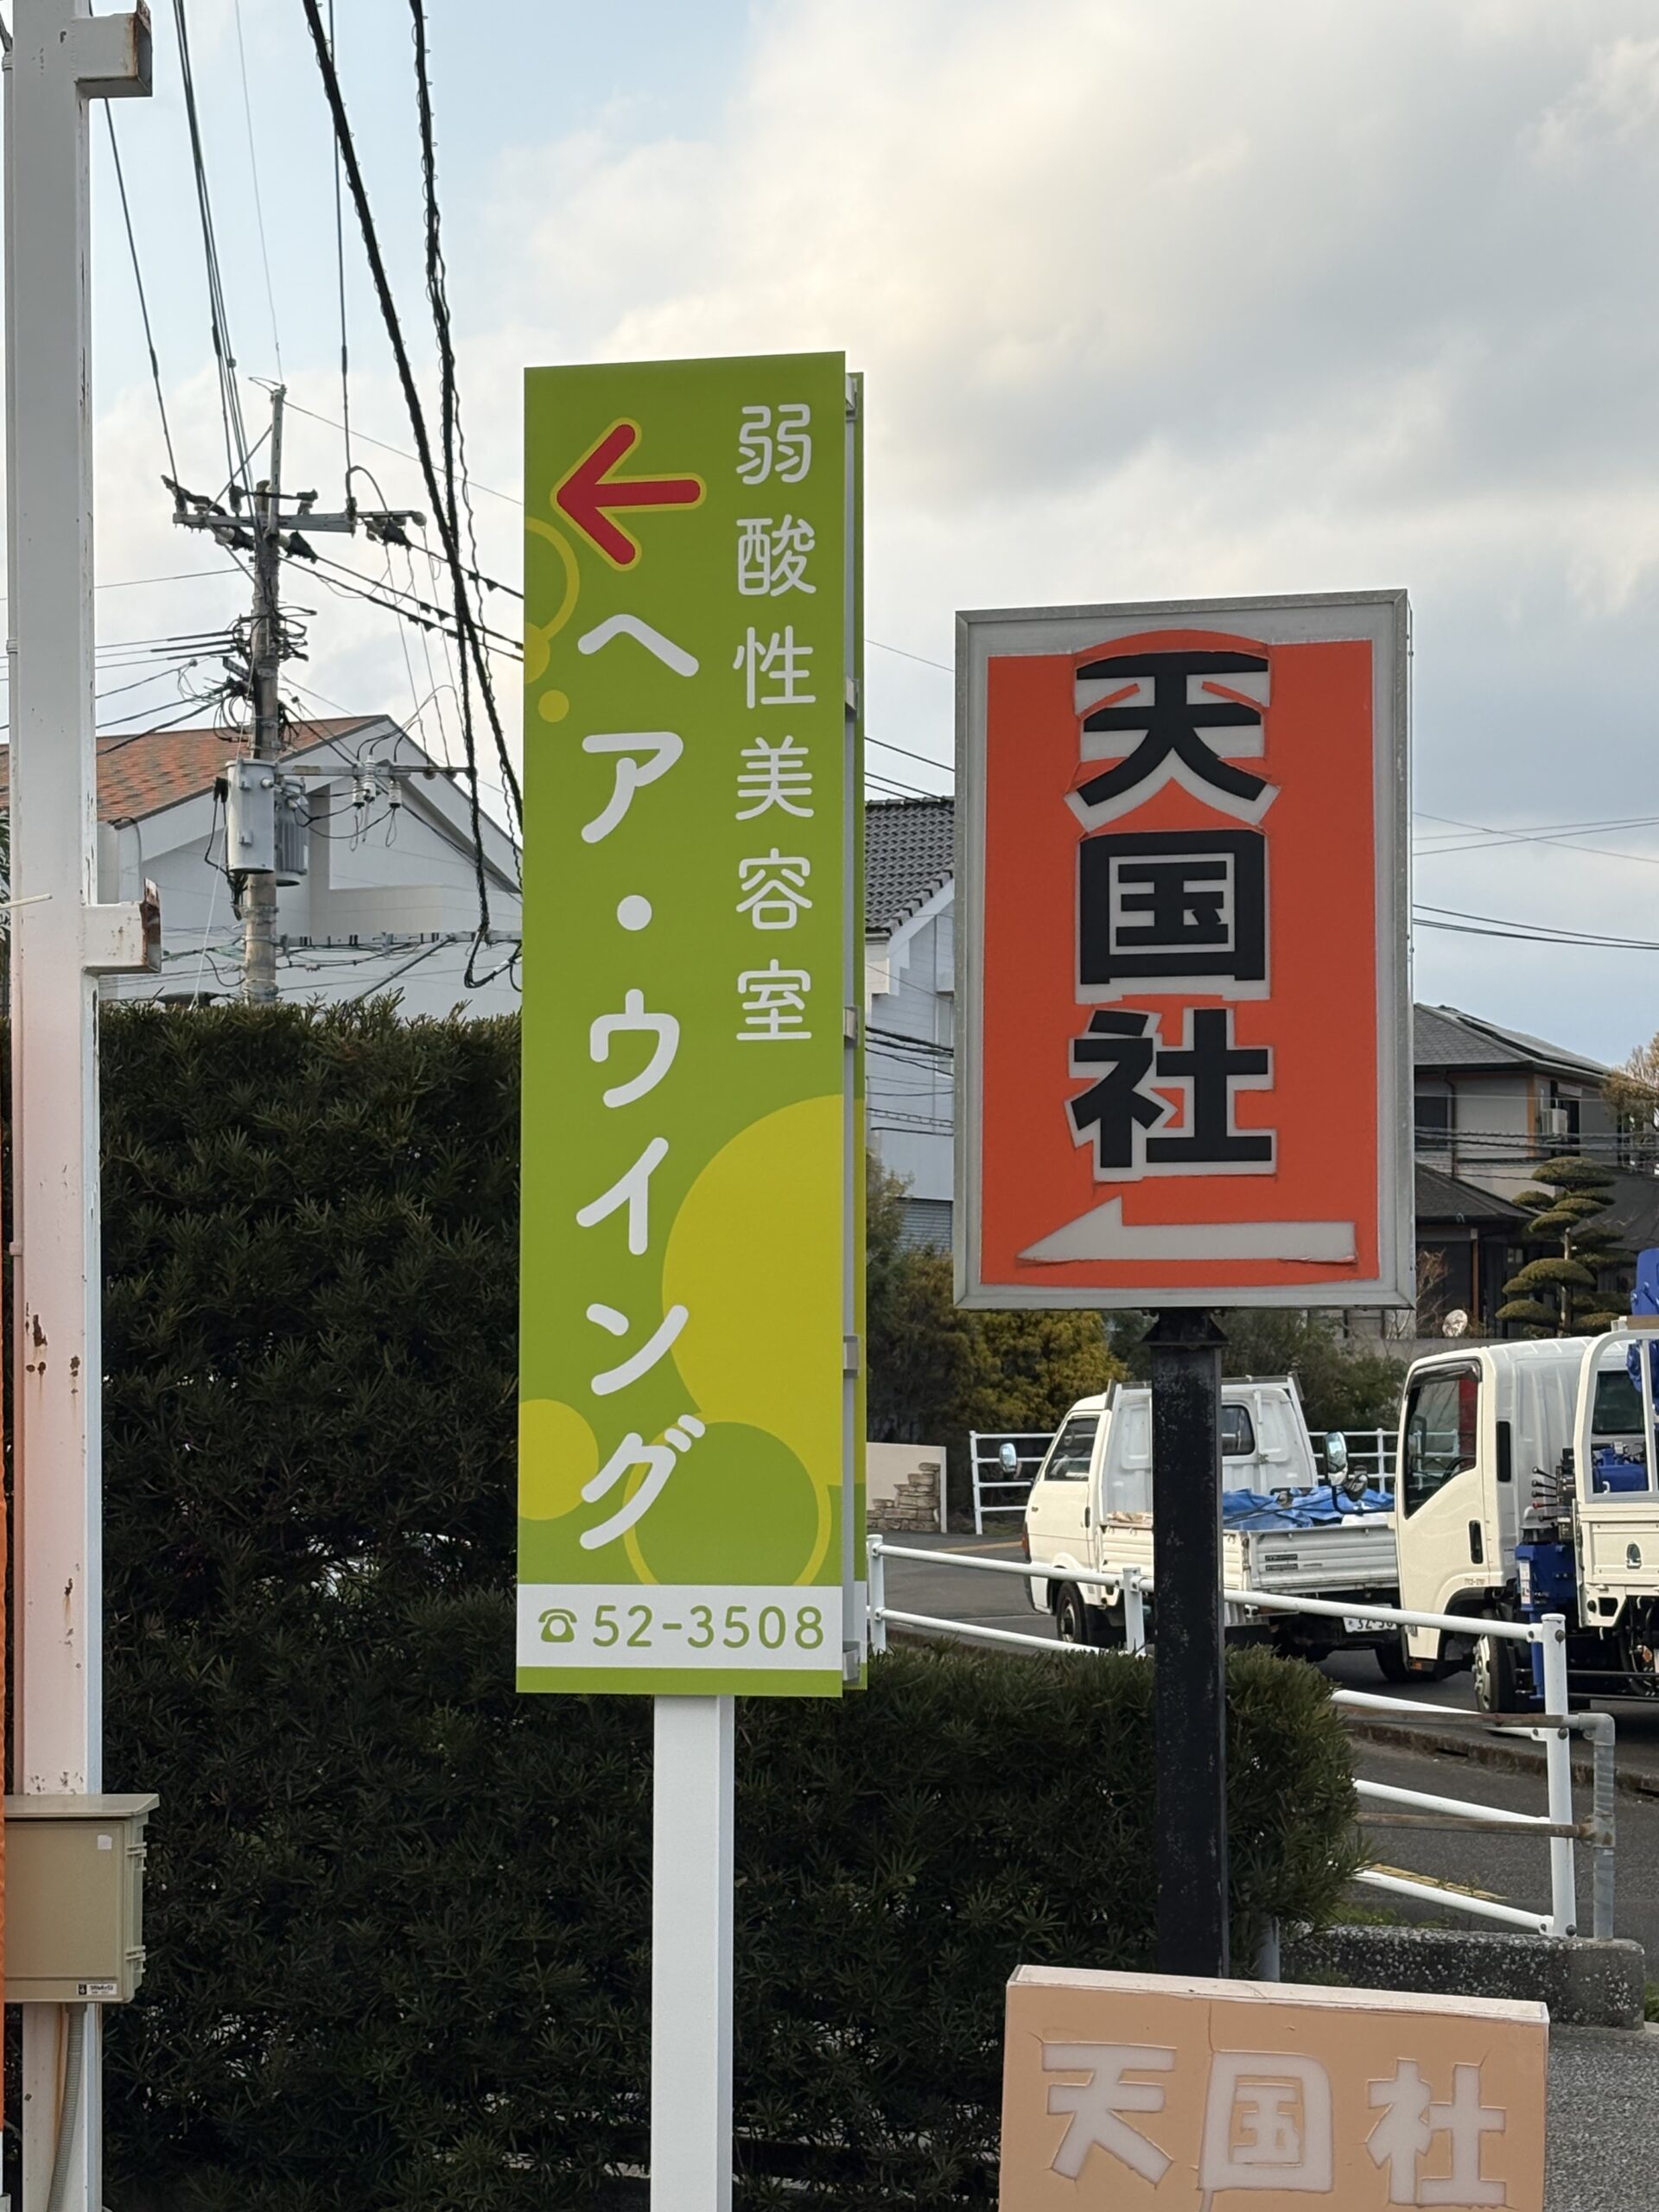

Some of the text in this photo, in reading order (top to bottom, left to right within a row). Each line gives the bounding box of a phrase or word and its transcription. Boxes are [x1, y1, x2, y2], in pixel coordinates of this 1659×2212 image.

[734, 403, 817, 1040] 弱酸性美容室
[1071, 651, 1272, 1169] 天国社
[575, 613, 706, 1550] ヘア・ウイング
[592, 1605, 824, 1649] 52-3508
[1040, 2043, 1506, 2204] 天国社
